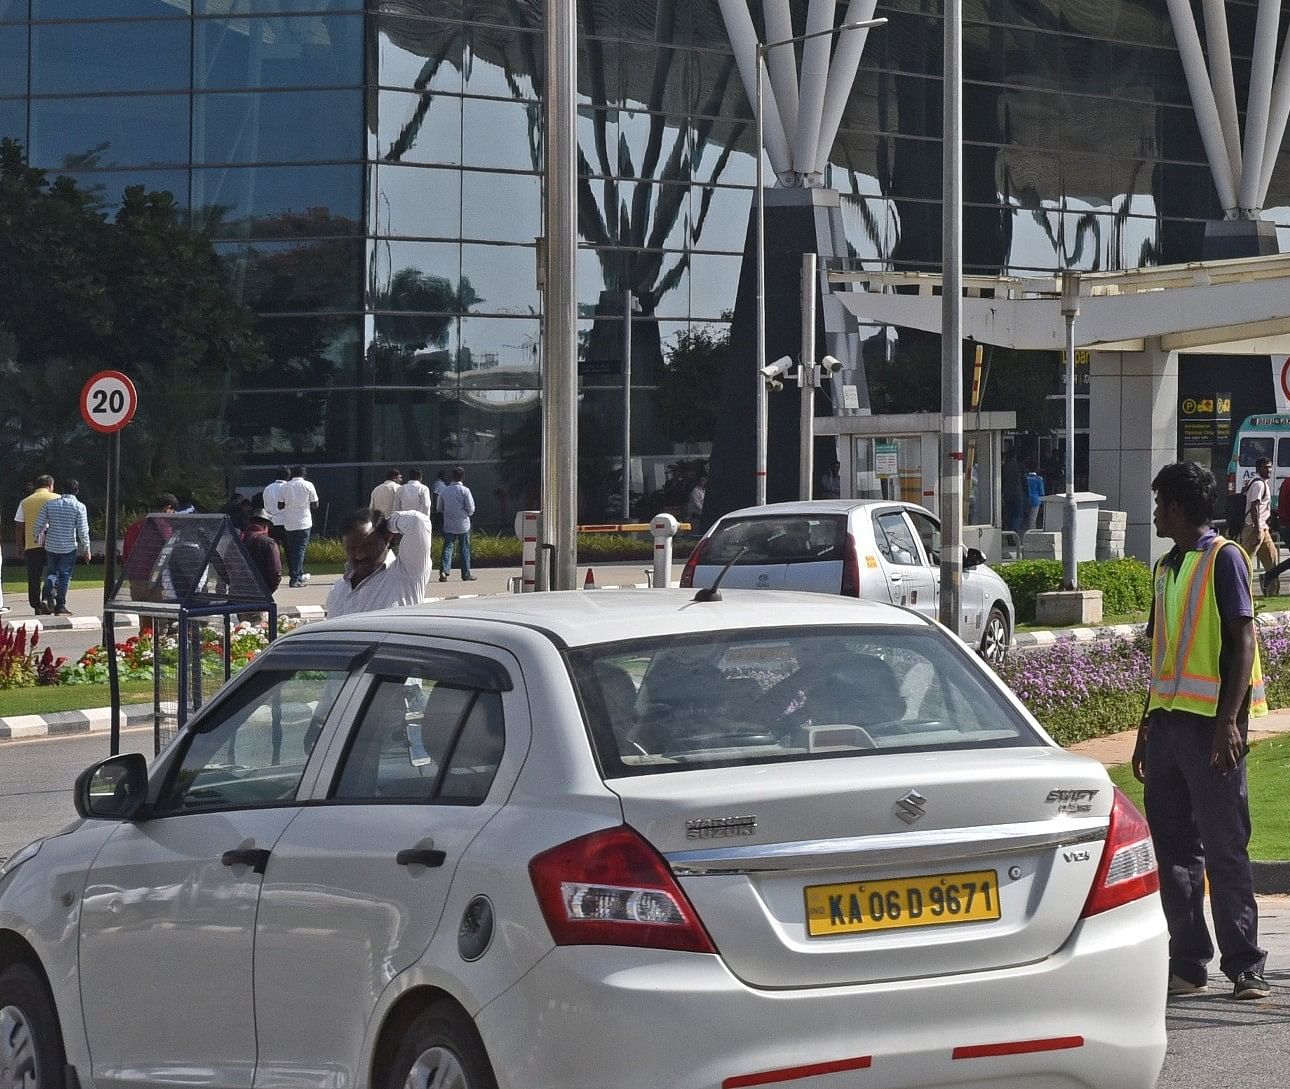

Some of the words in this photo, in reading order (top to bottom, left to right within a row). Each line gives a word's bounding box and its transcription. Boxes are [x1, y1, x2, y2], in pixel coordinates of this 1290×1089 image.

[92, 389, 125, 414] 20
[1043, 789, 1100, 804] SWIFT
[829, 894, 863, 926] KA
[868, 891, 901, 922] 06
[908, 887, 923, 919] D
[928, 881, 993, 917] 9671
